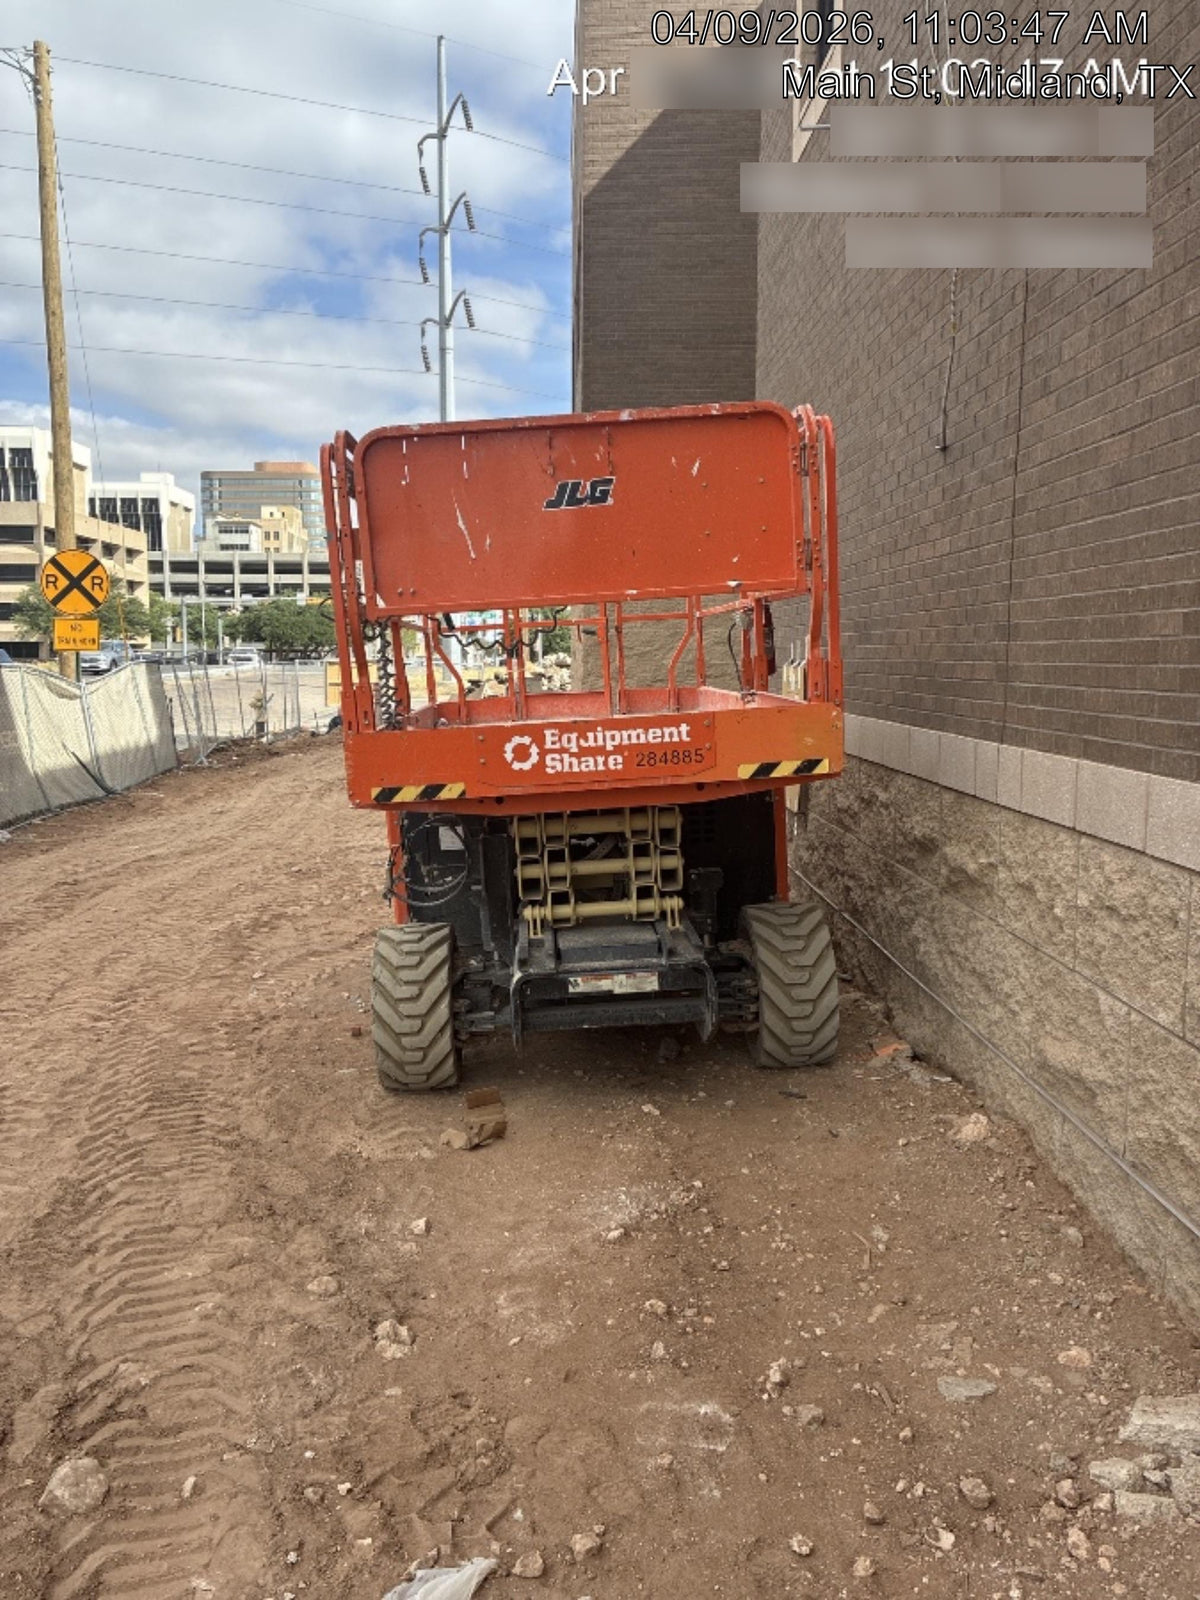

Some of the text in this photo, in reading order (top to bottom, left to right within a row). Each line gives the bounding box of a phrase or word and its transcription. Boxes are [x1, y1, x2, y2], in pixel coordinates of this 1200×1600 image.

[542, 476, 616, 511] JLG
[45, 574, 104, 592] R R
[544, 723, 691, 752] Equipment
[544, 753, 624, 774] Share
[636, 748, 705, 768] 284885
